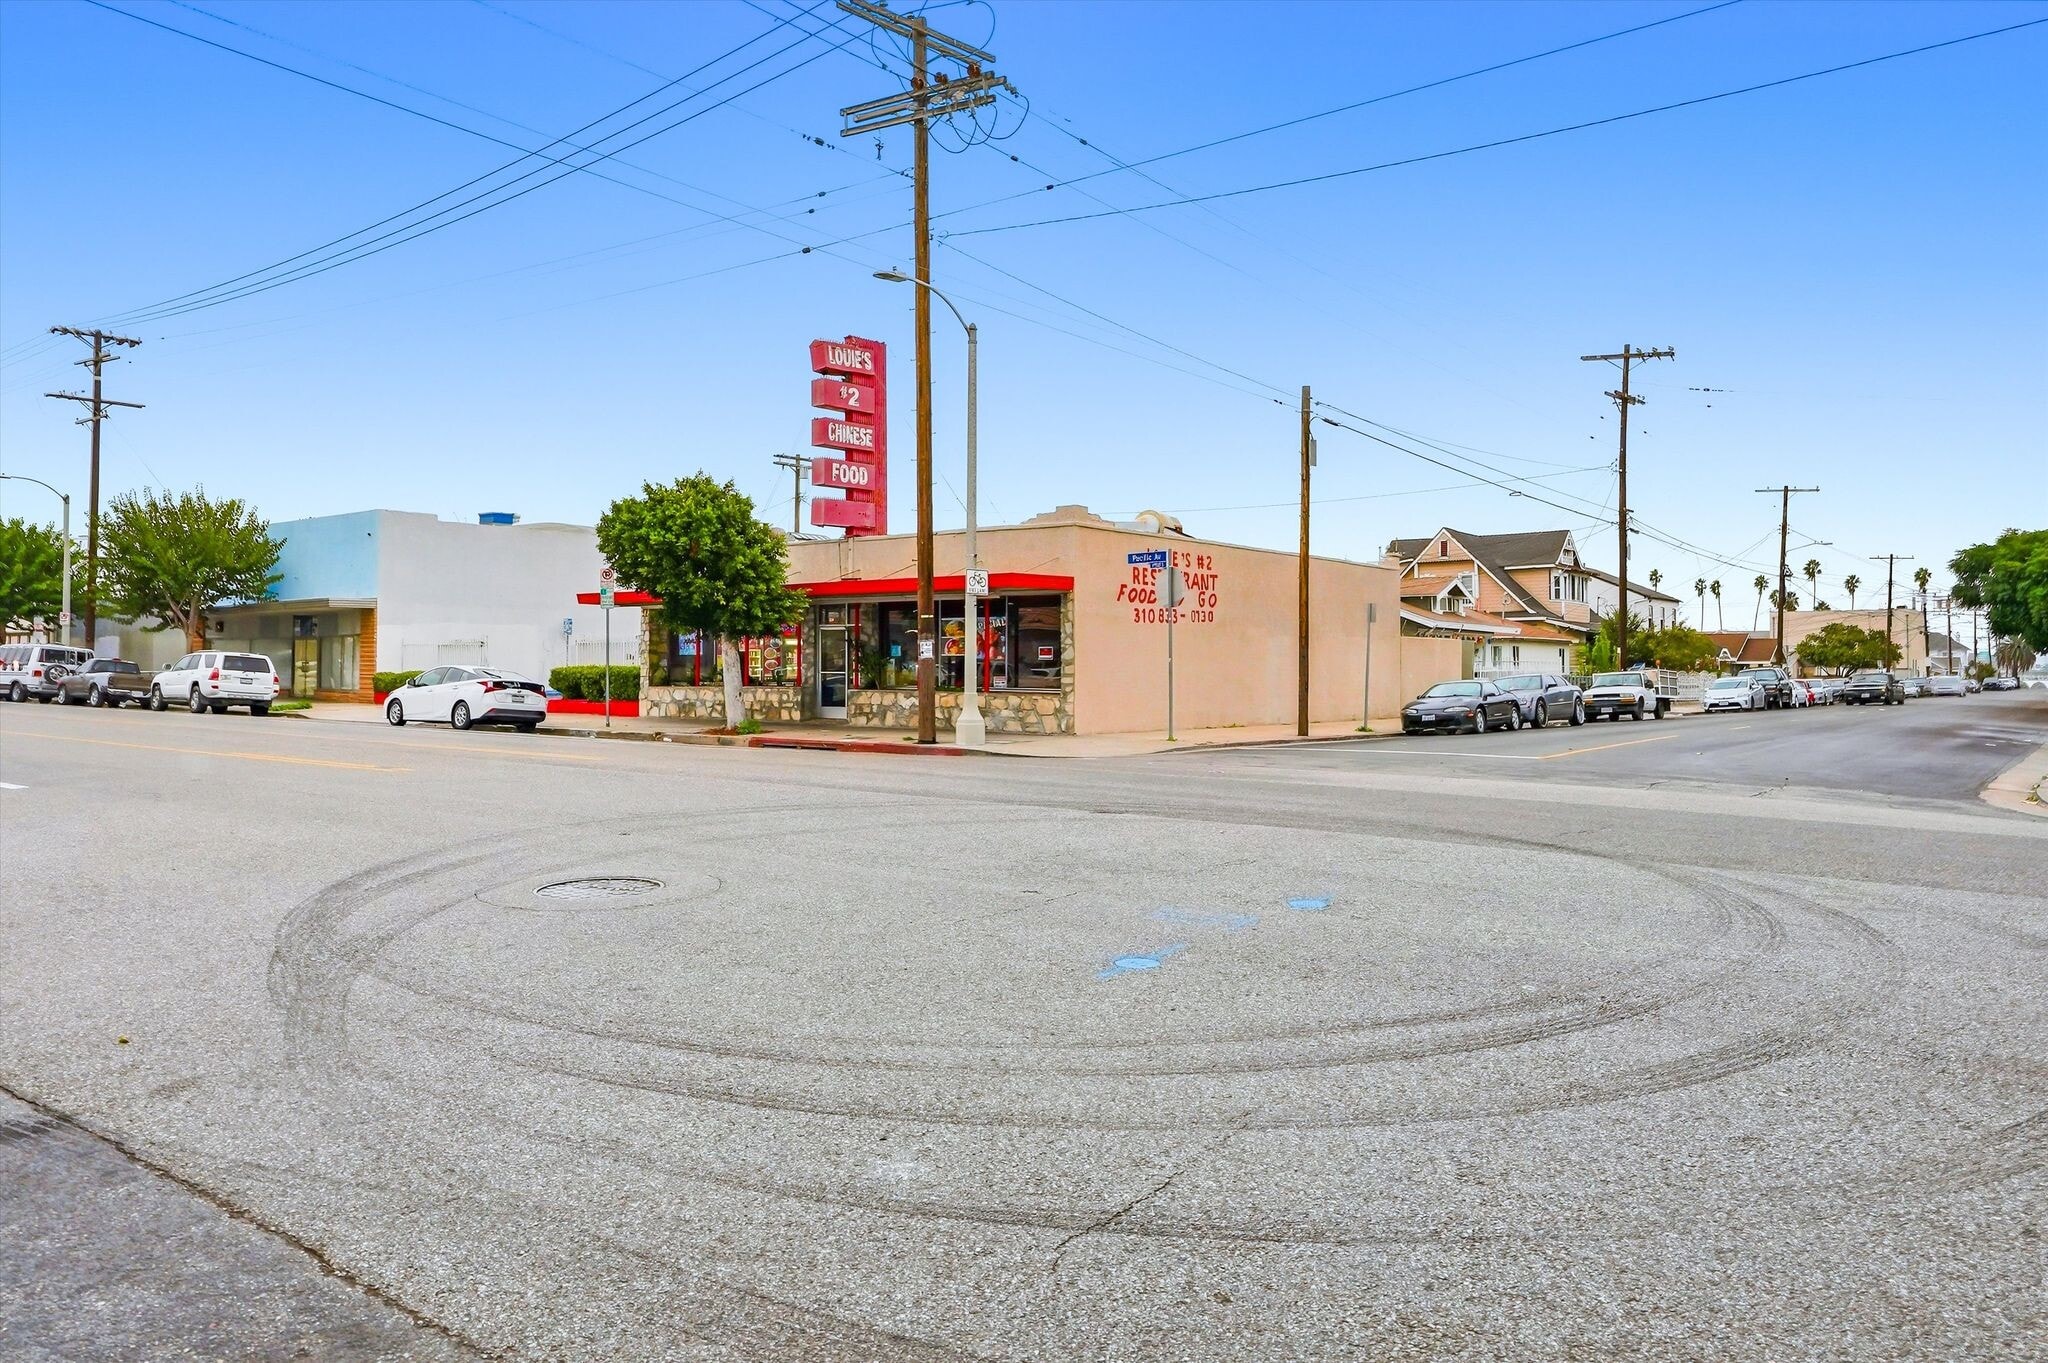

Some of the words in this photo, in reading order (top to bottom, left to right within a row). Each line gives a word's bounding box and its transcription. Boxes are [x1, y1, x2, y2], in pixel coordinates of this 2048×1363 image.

[828, 345, 872, 371] LOUIE'S
[840, 386, 860, 407] #2
[828, 422, 873, 447] CHINESE
[832, 462, 868, 486] FOOD
[1197, 555, 1212, 570] #2
[1132, 566, 1218, 592] RESRANT
[1116, 583, 1157, 604] FOOD
[1198, 591, 1217, 608] GO
[1134, 607, 1156, 624] 310
